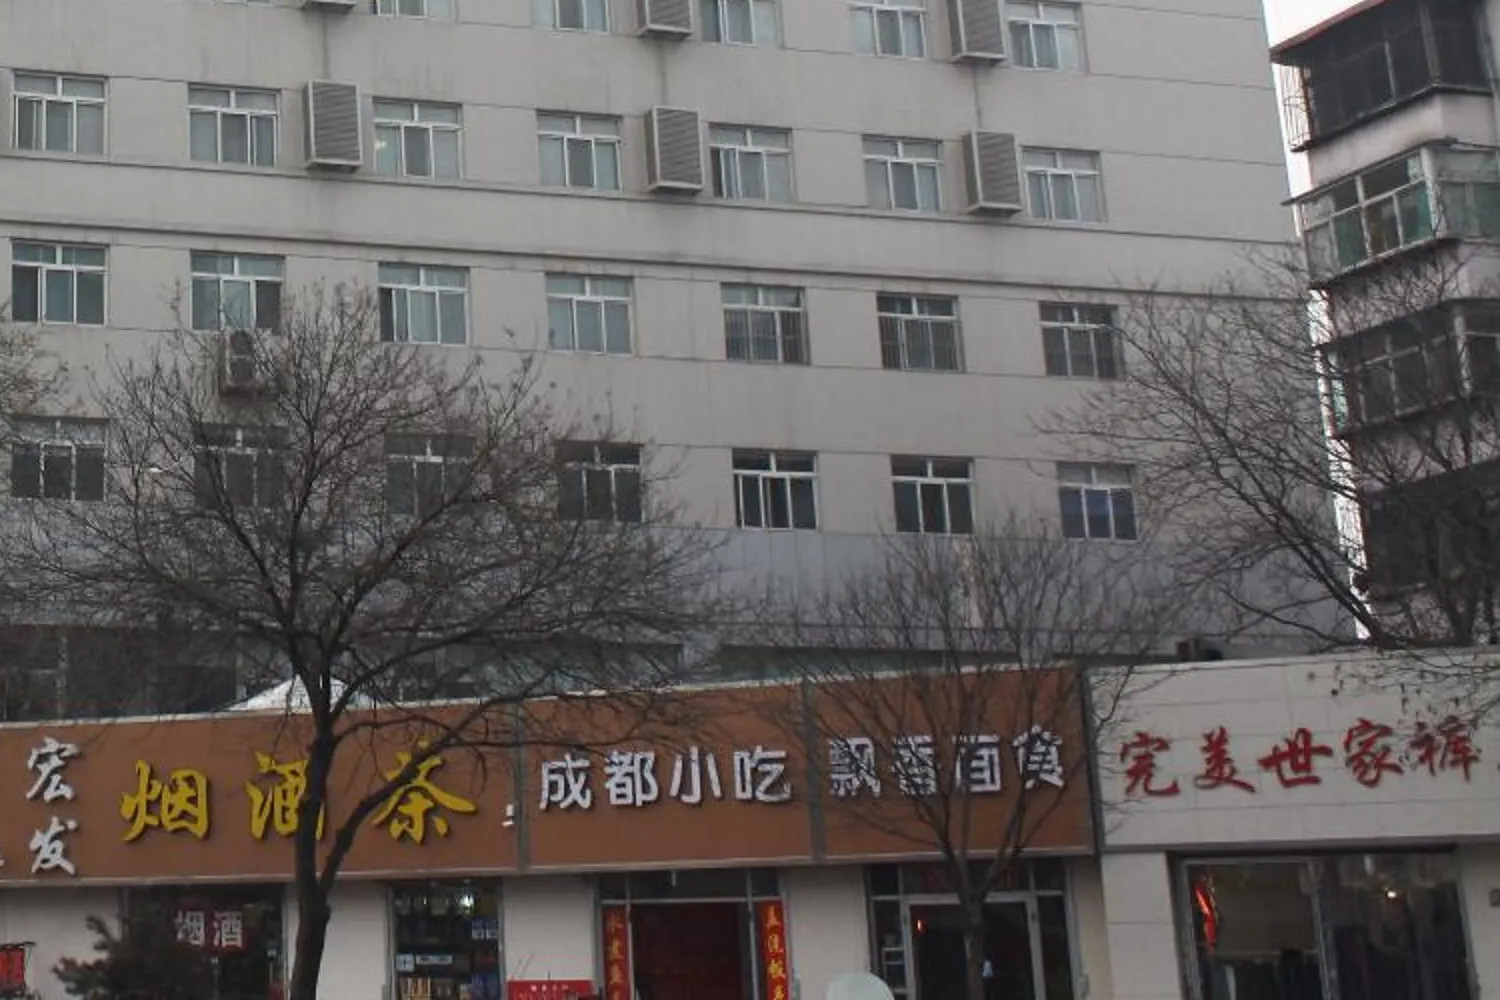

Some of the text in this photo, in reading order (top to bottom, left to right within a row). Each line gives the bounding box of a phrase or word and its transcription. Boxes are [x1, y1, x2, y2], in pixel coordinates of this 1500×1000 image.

[26, 736, 82, 875] 宏发
[119, 739, 478, 844] 烟酒茶
[539, 744, 791, 811] 成都小吃
[173, 908, 243, 948] 烟酒
